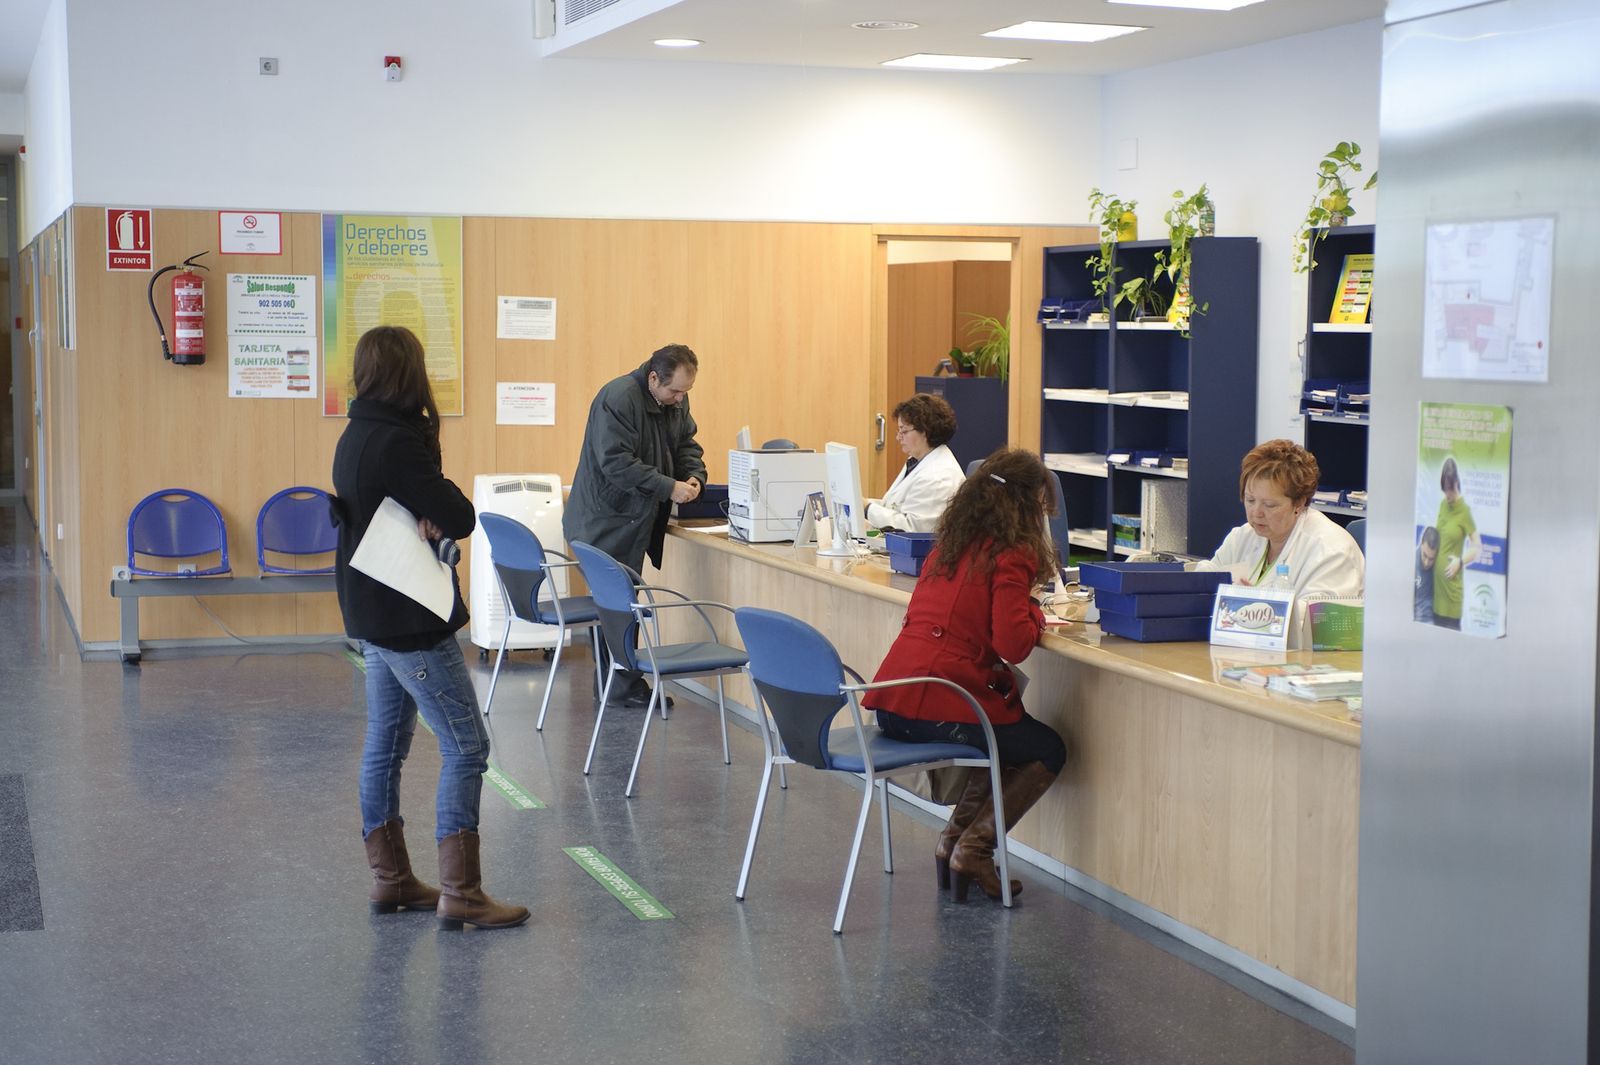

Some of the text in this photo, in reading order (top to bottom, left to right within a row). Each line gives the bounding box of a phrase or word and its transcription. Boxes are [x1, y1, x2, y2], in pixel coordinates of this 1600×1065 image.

[345, 223, 427, 241] Derechos
[345, 240, 429, 256] y deberes
[113, 257, 147, 265] EXTINTOR
[352, 271, 390, 281] derechos
[246, 279, 265, 294] Salud
[265, 281, 295, 294] Responde
[258, 299, 296, 309] 902 505 060
[237, 344, 282, 353] TARJETA
[234, 357, 287, 366] SANITARIA
[1240, 606, 1273, 624] 2009
[571, 847, 664, 918] POR FAVOR ESPERE SU TURNO
